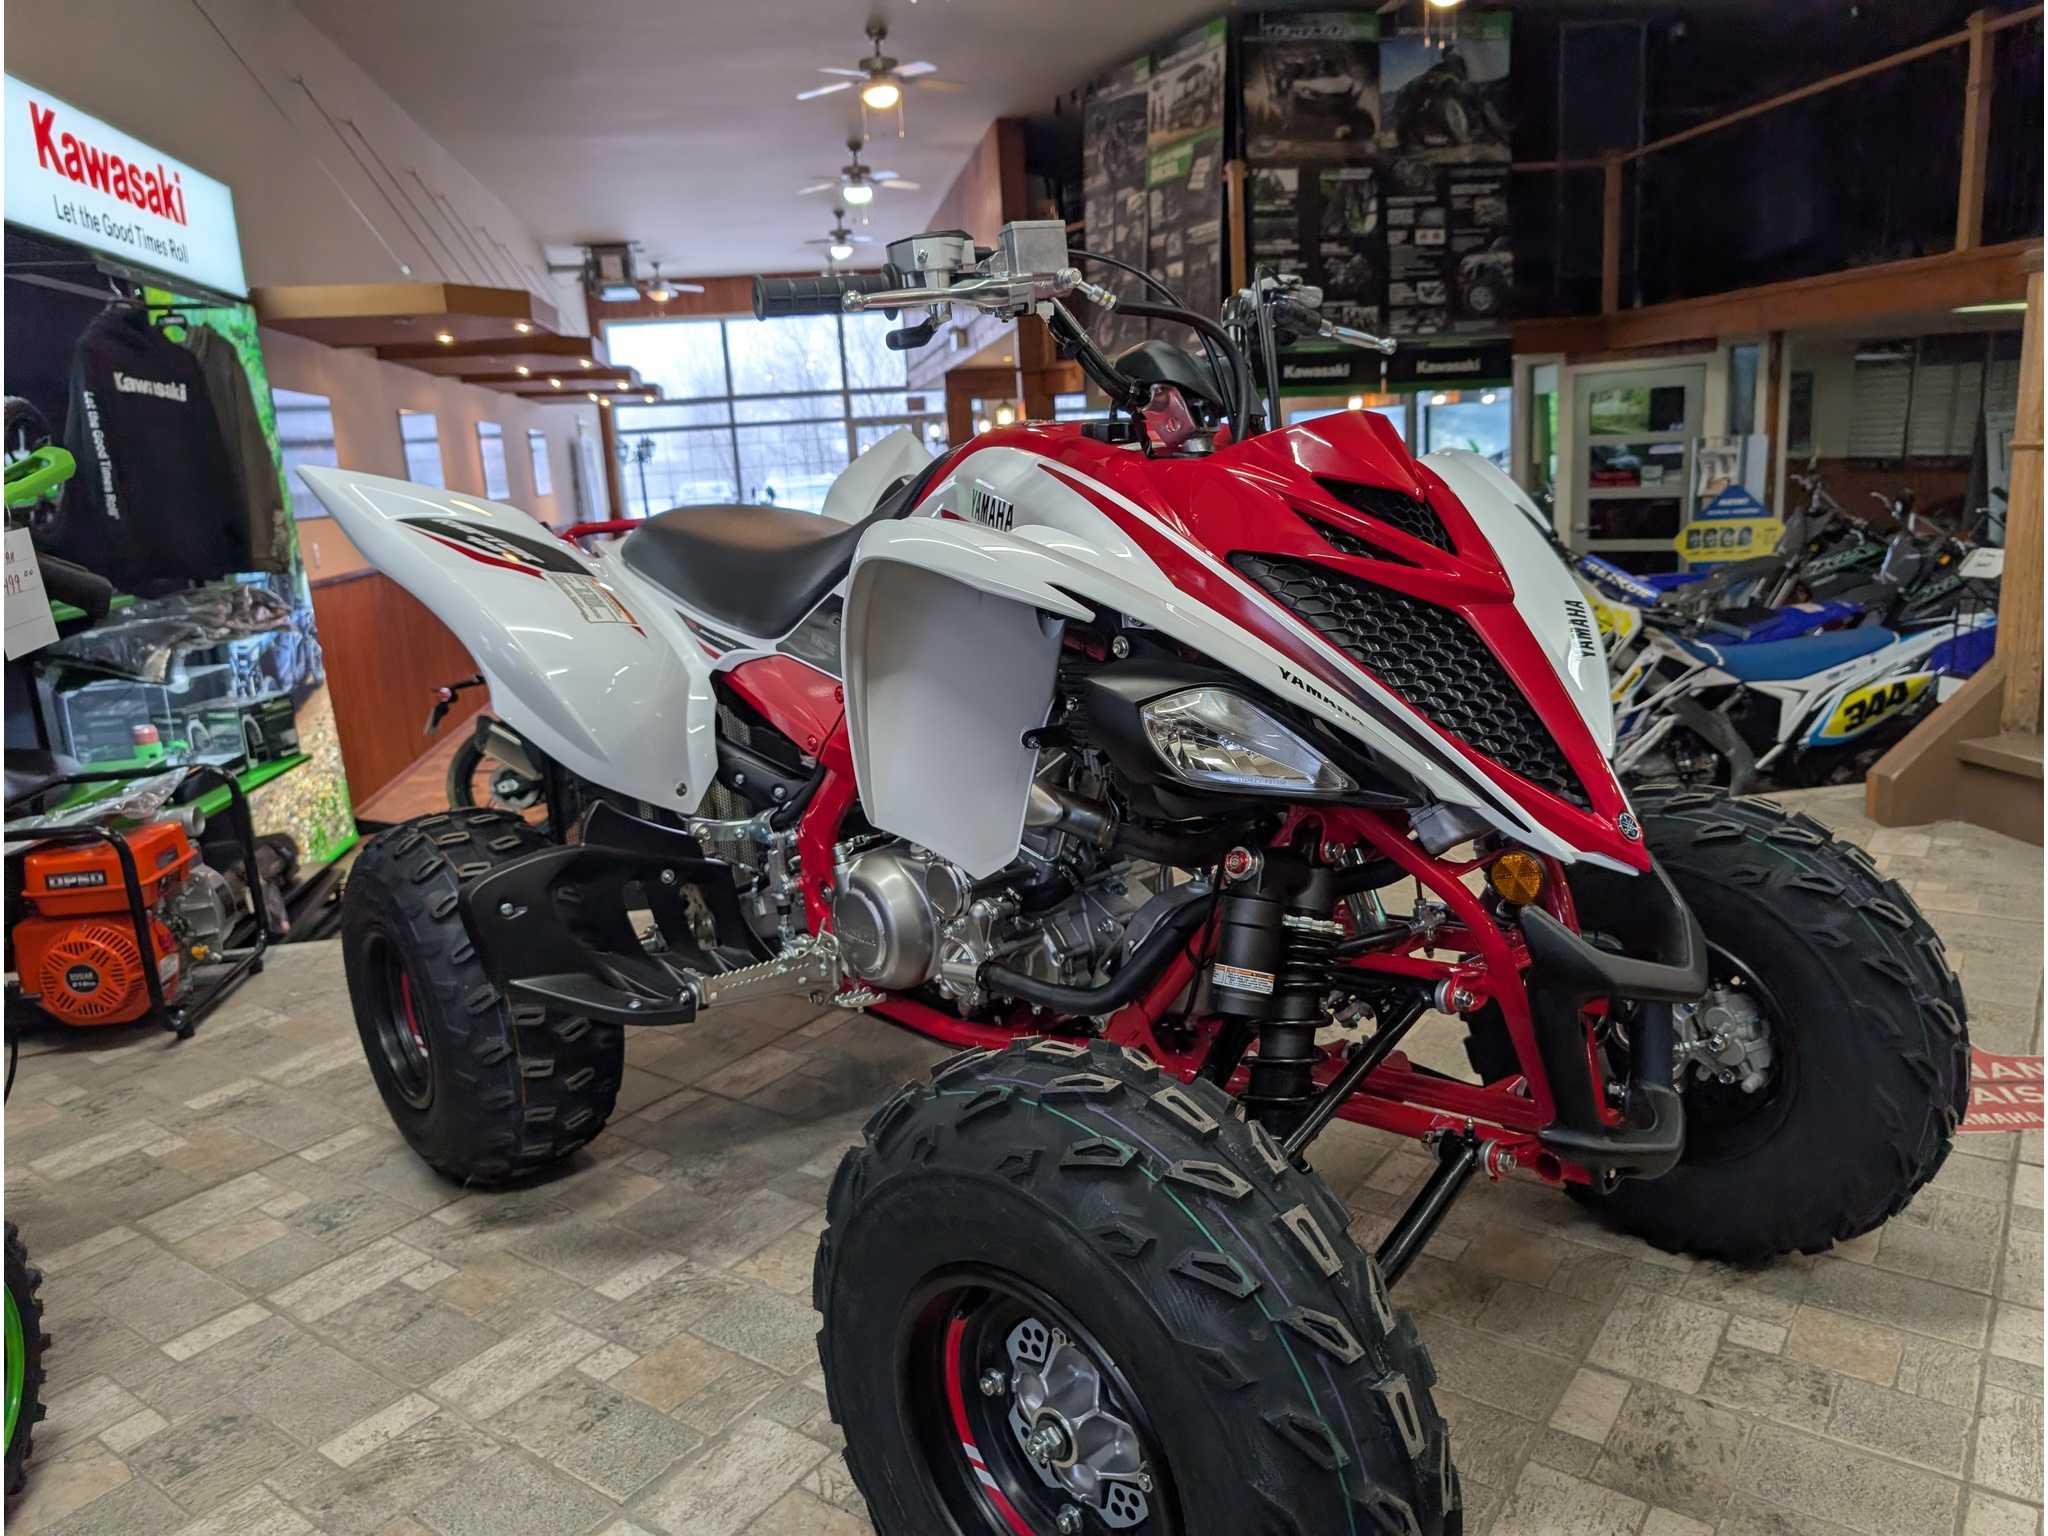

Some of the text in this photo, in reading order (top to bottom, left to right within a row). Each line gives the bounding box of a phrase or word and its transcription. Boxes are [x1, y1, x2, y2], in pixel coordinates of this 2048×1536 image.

[28, 99, 187, 226] Kawasaki
[53, 194, 190, 265] Let the Good Times Roll
[1283, 362, 1350, 379] Kawasaki
[1416, 357, 1482, 375] Kawasaki
[83, 390, 97, 411] Let
[113, 371, 188, 403] Kawasaki
[87, 410, 100, 429] the
[91, 429, 110, 460] Good
[100, 459, 114, 493] Times
[970, 488, 1015, 533] YAMAHA
[1564, 599, 1596, 658] YAMAHA
[1278, 665, 1365, 727] YAMAHA
[1844, 680, 1909, 733] 344
[1970, 1085, 2044, 1105] AIS
[1962, 1111, 2044, 1125] AMAHA
